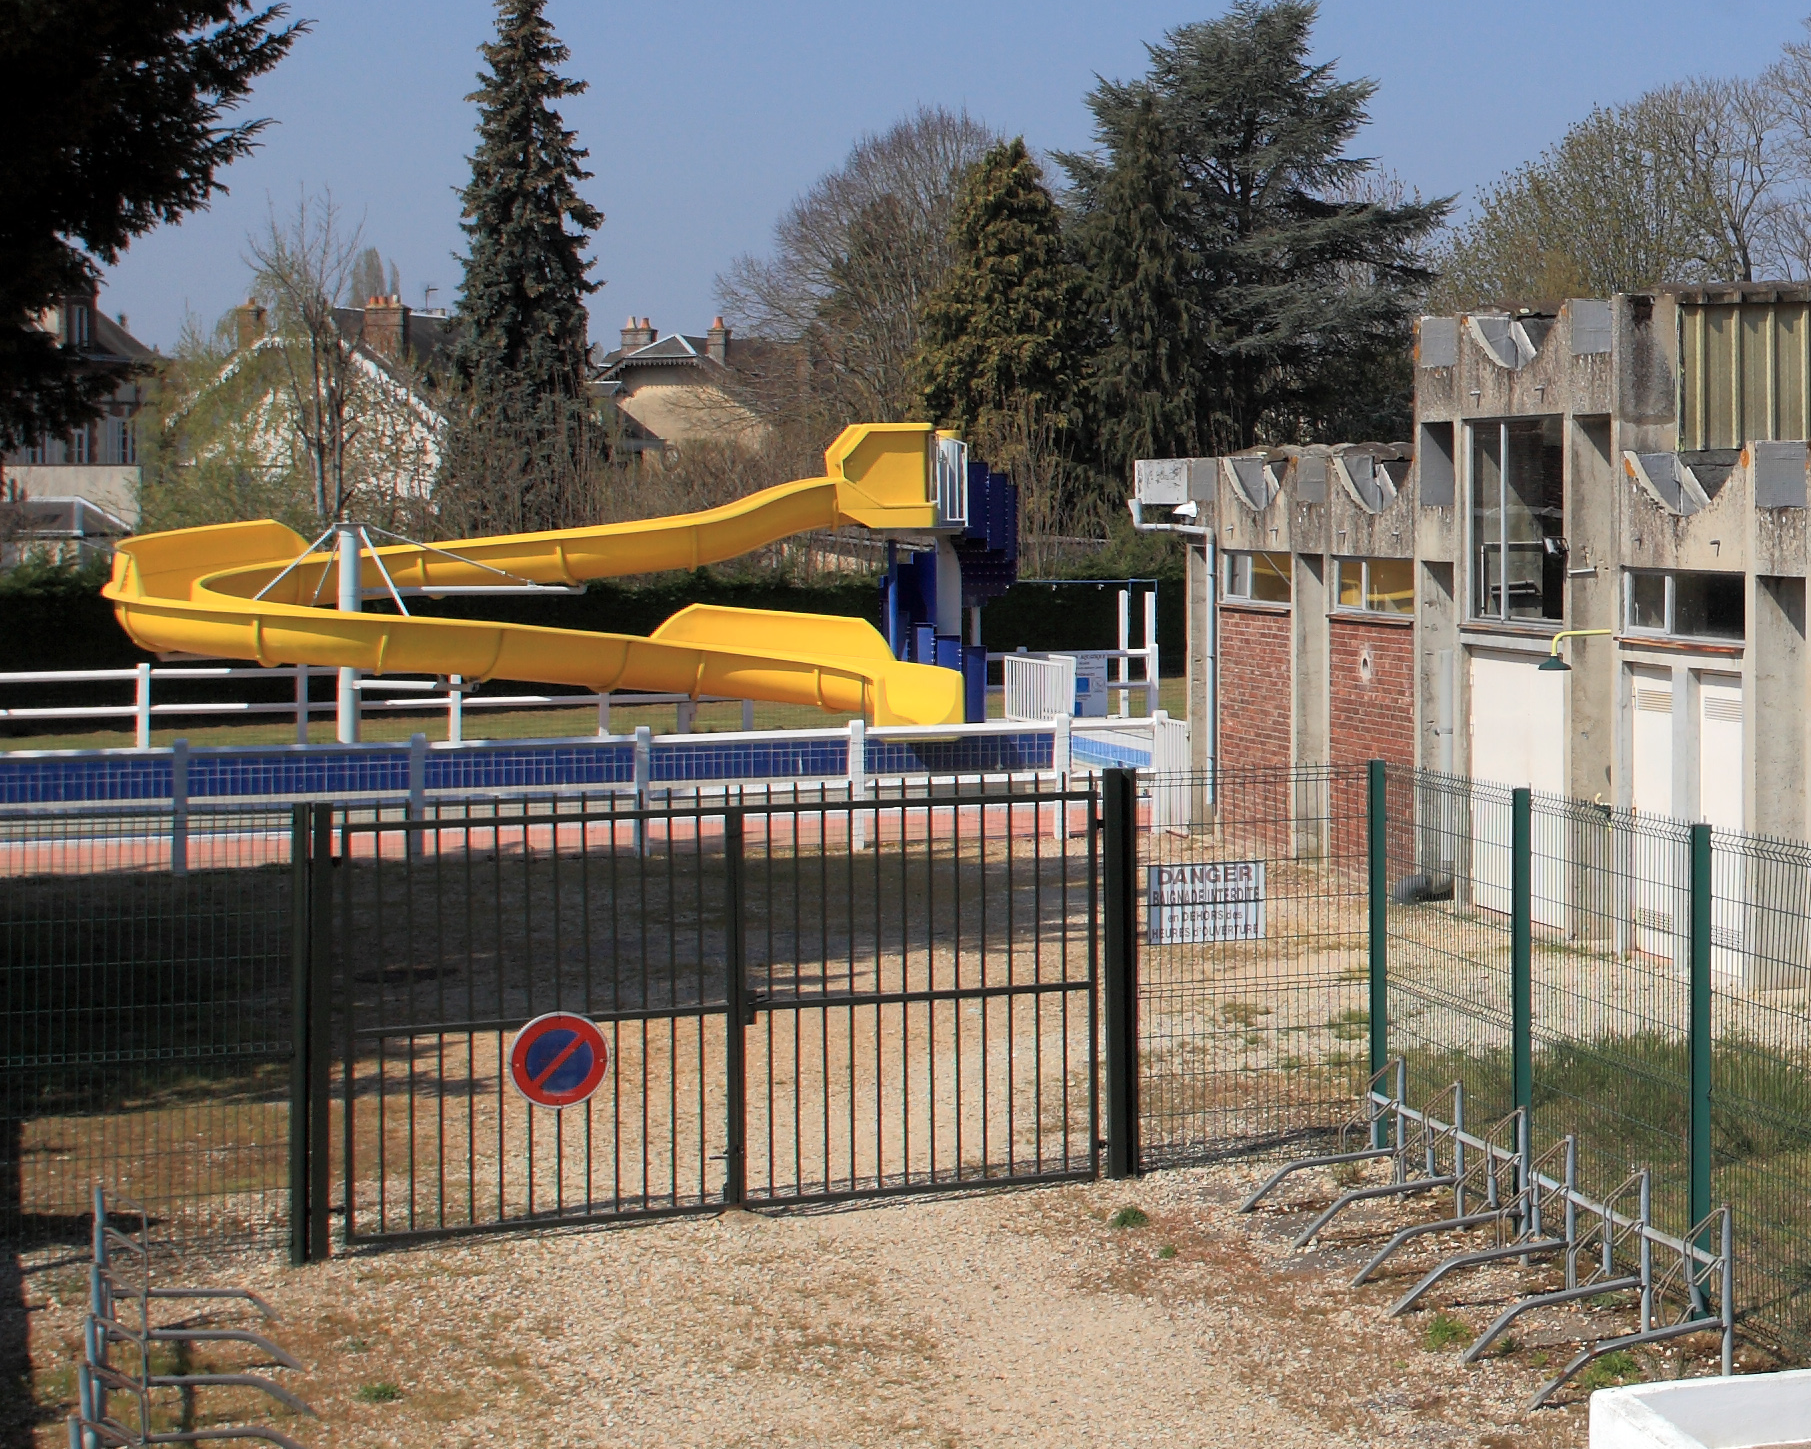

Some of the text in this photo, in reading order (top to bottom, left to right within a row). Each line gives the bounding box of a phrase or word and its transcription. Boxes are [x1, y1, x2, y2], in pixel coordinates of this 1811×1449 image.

[1158, 865, 1253, 885] DANGER
[1153, 886, 1260, 905] BAIGNADE INTERDITE
[1168, 910, 1244, 923] en DEHORS des
[1152, 927, 1191, 939] HEURES
